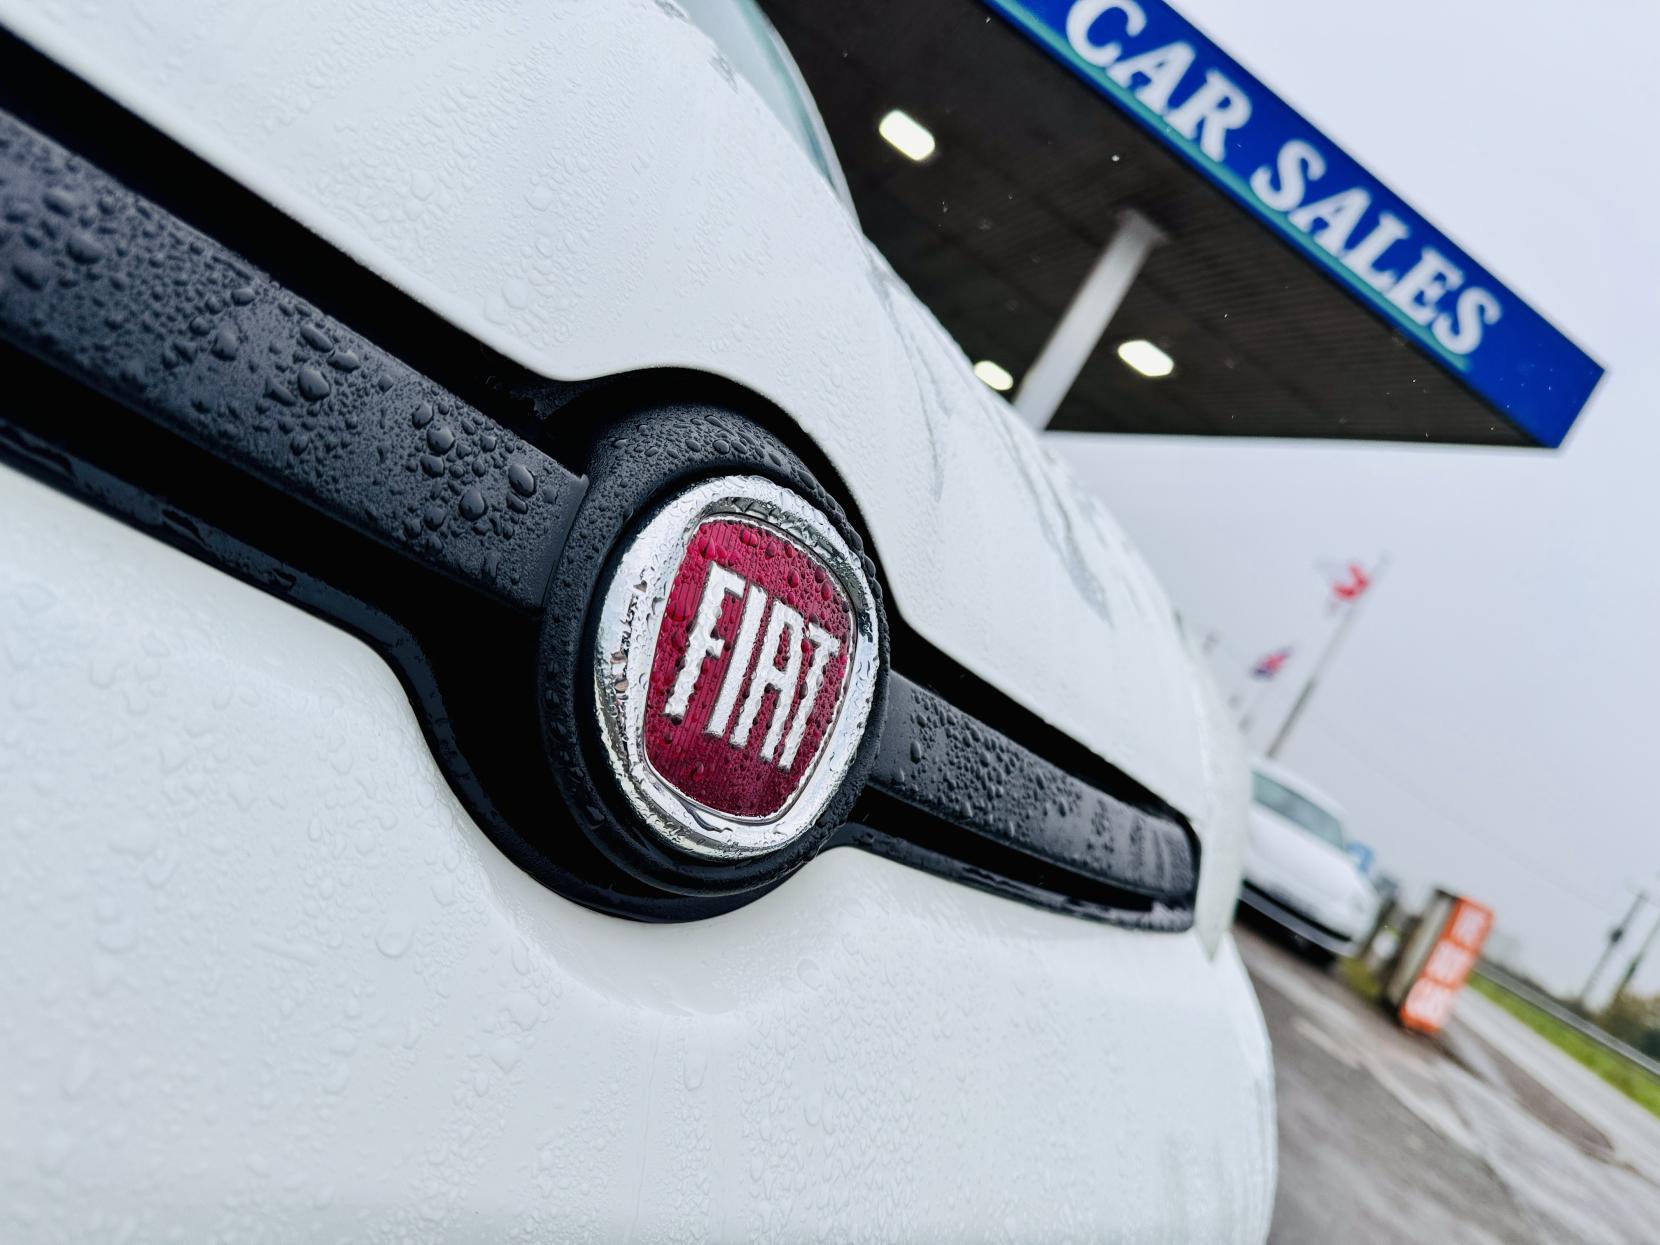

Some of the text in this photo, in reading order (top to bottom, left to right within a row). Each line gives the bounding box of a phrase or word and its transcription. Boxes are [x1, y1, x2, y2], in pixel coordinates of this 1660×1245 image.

[1065, 0, 1502, 355] CAR SALES
[663, 561, 841, 772] FIAT
